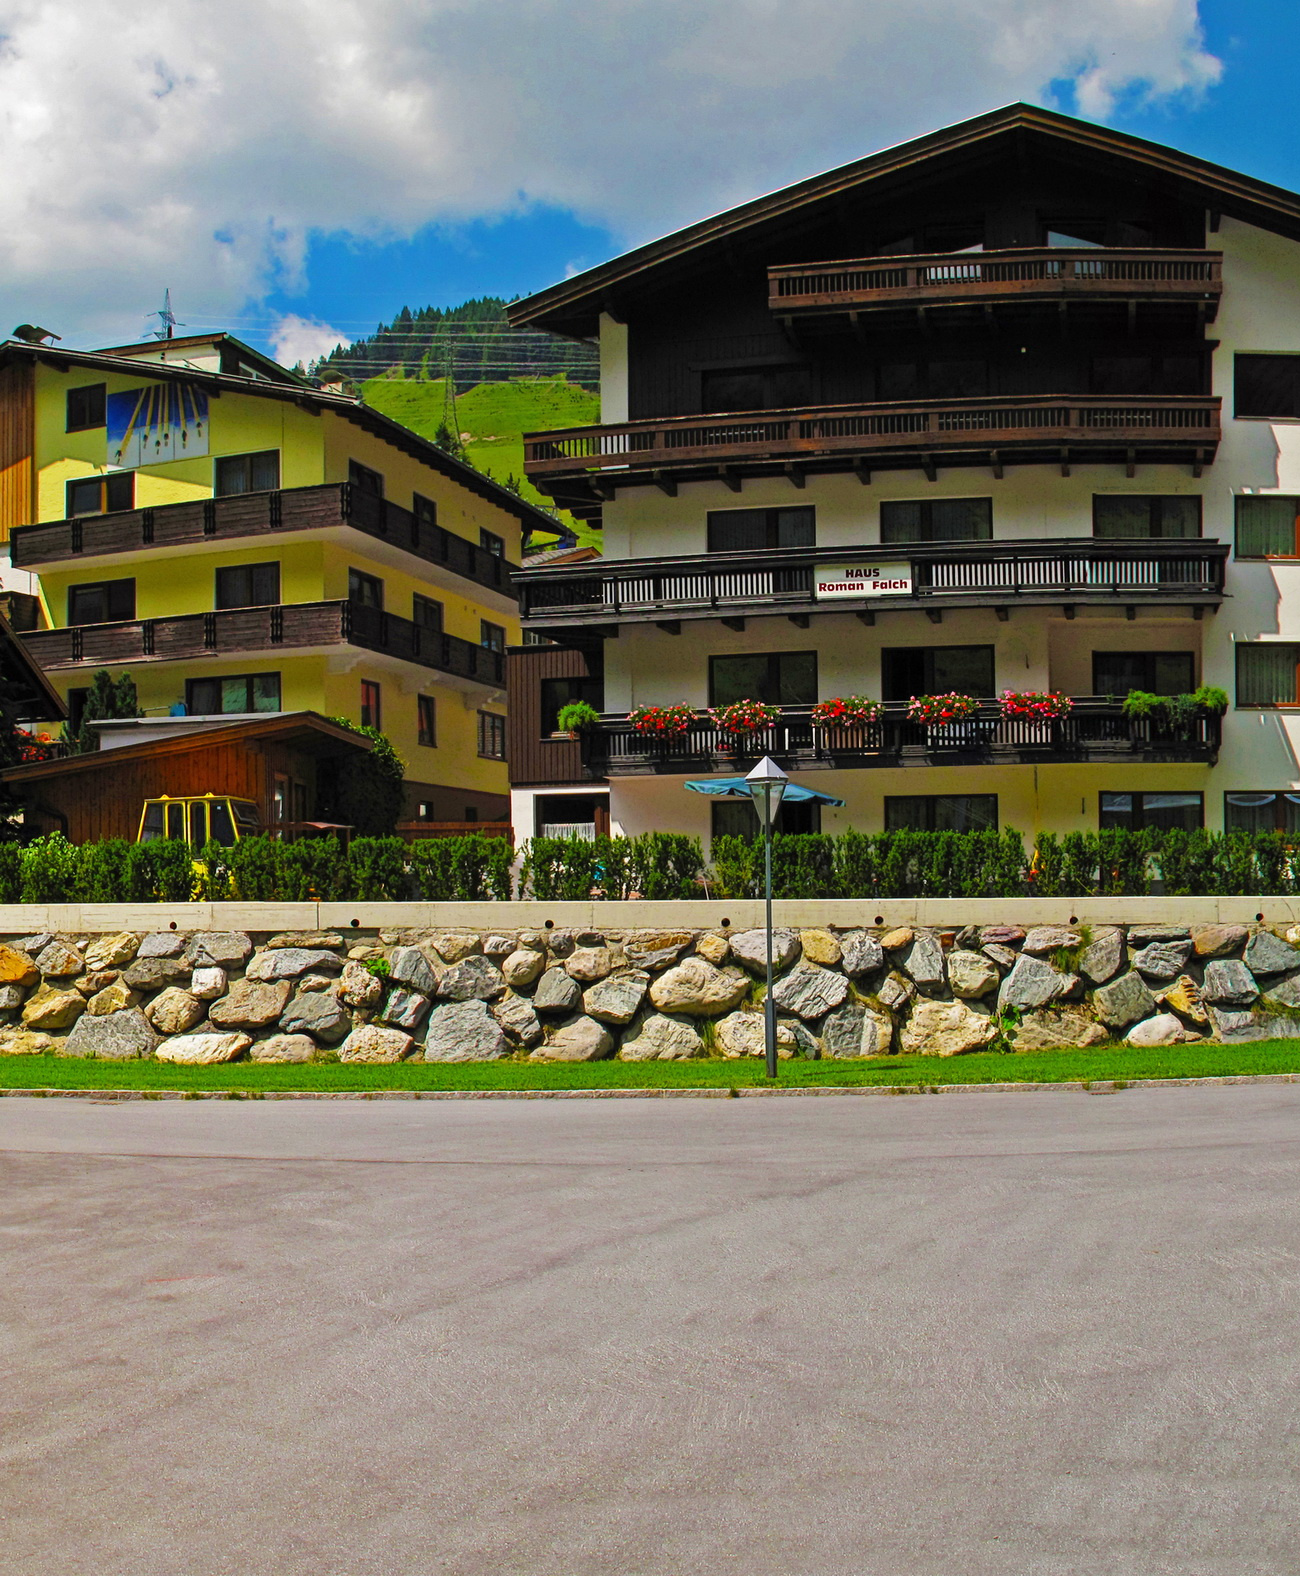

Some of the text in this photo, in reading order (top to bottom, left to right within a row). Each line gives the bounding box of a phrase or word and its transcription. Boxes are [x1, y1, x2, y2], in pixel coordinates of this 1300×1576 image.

[846, 568, 880, 578] HAUS
[819, 579, 908, 592] Roman Falch
